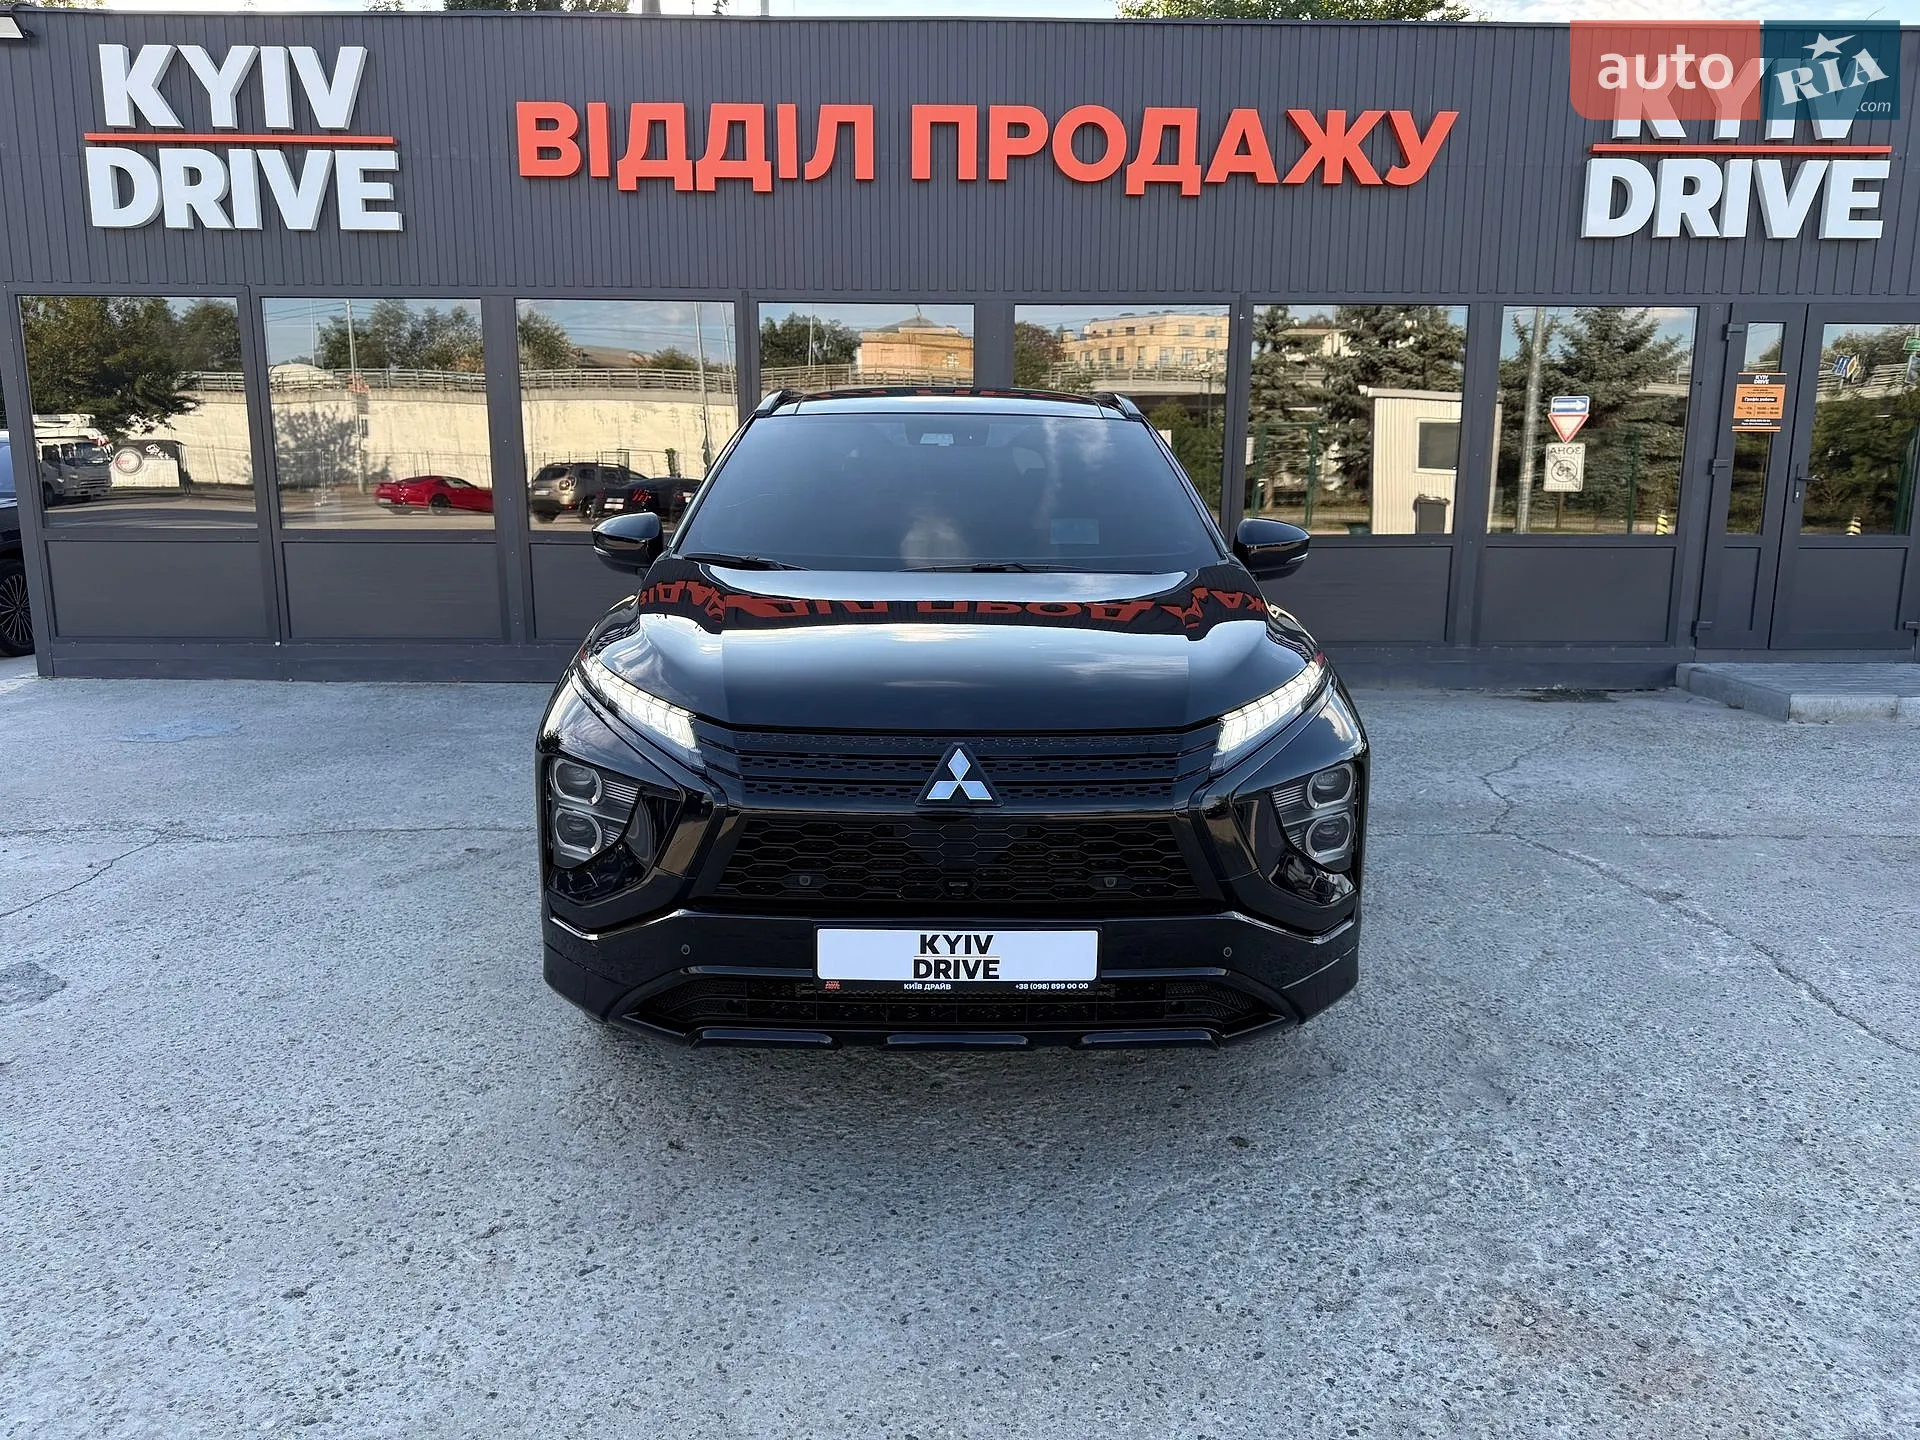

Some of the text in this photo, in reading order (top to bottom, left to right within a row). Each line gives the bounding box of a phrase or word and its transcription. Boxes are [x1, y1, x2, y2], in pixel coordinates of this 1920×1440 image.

[99, 44, 368, 130] KYIV
[1612, 57, 1879, 140] KYIV
[85, 147, 403, 231] DRIVE
[516, 101, 1460, 196] ВІДДІЛ ПРОДАЖУ
[1581, 158, 1891, 240] DRIVE
[913, 959, 1000, 979] DRIVE
[920, 934, 993, 955] KYIV
[903, 982, 952, 991] КИЇВ ДРАЙВ
